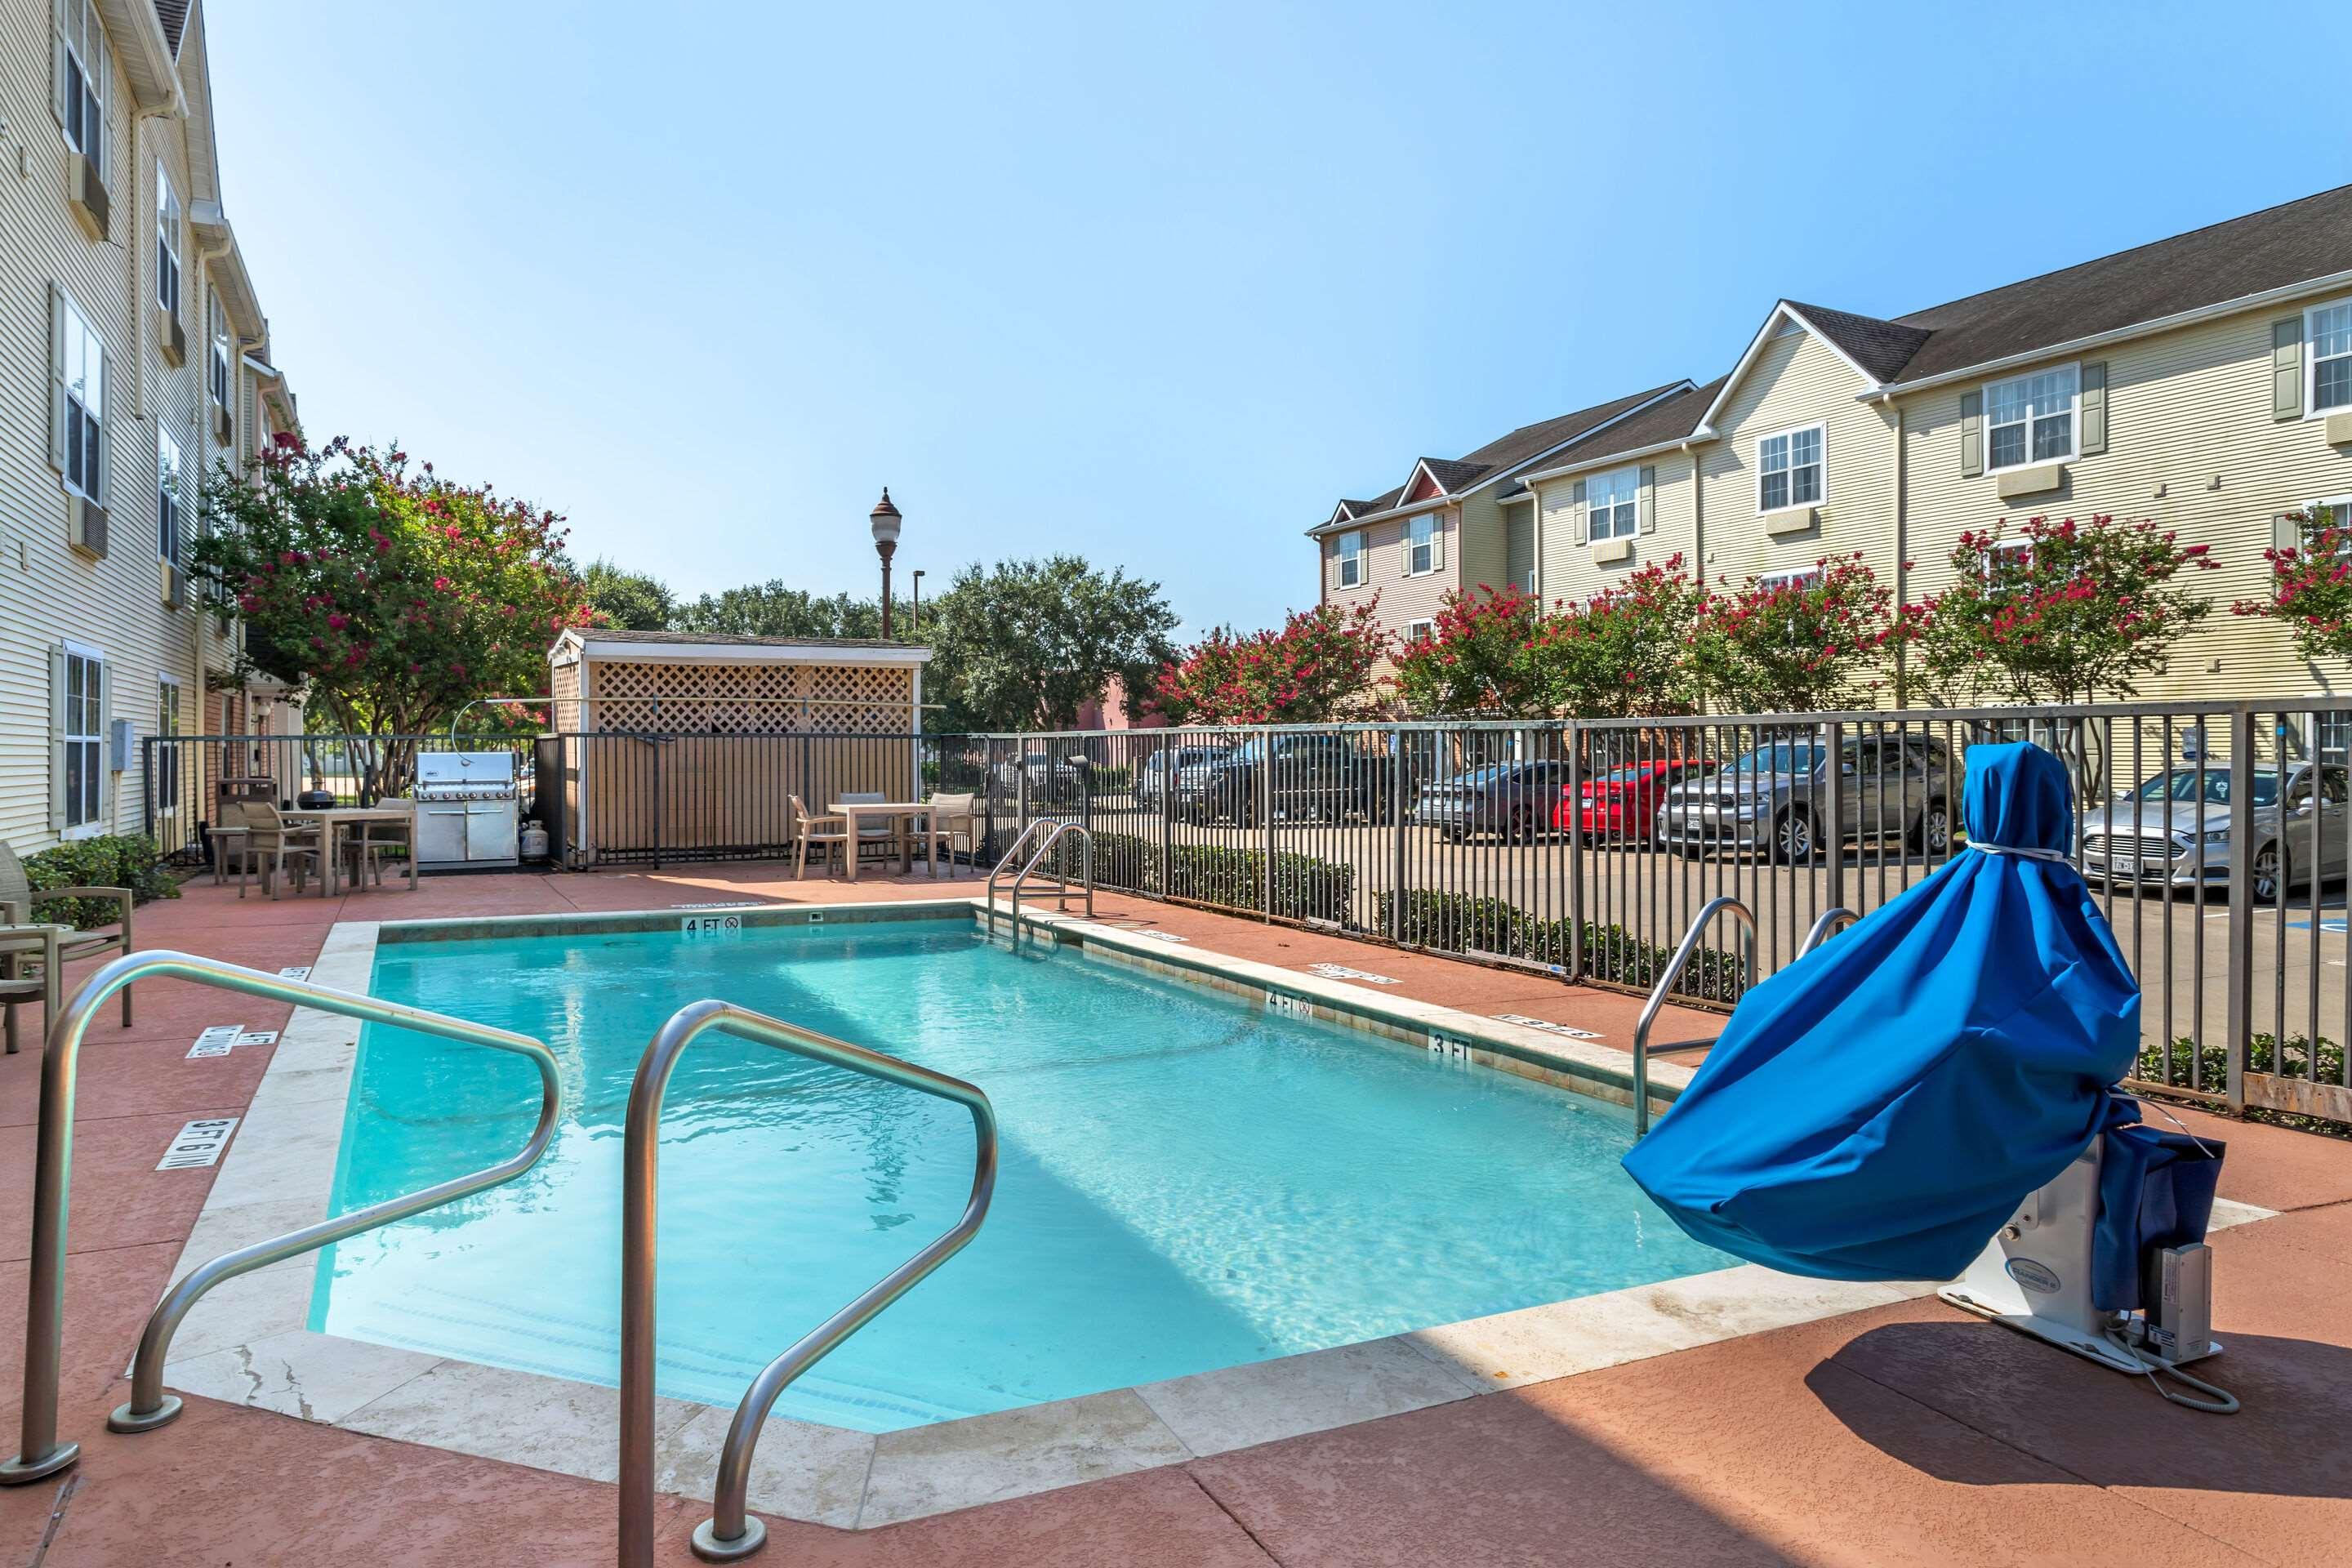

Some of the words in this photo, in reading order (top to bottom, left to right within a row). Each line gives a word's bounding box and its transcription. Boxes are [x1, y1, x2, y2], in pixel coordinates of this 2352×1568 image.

[687, 920, 697, 930] 4
[703, 919, 720, 929] FT
[1270, 991, 1277, 1005] 4
[1282, 993, 1295, 1010] FT
[1434, 1034, 1444, 1054] 3
[1452, 1039, 1470, 1060] FT
[182, 1129, 225, 1140] FT
[176, 1143, 216, 1152] 6
[166, 1154, 212, 1168] IN
